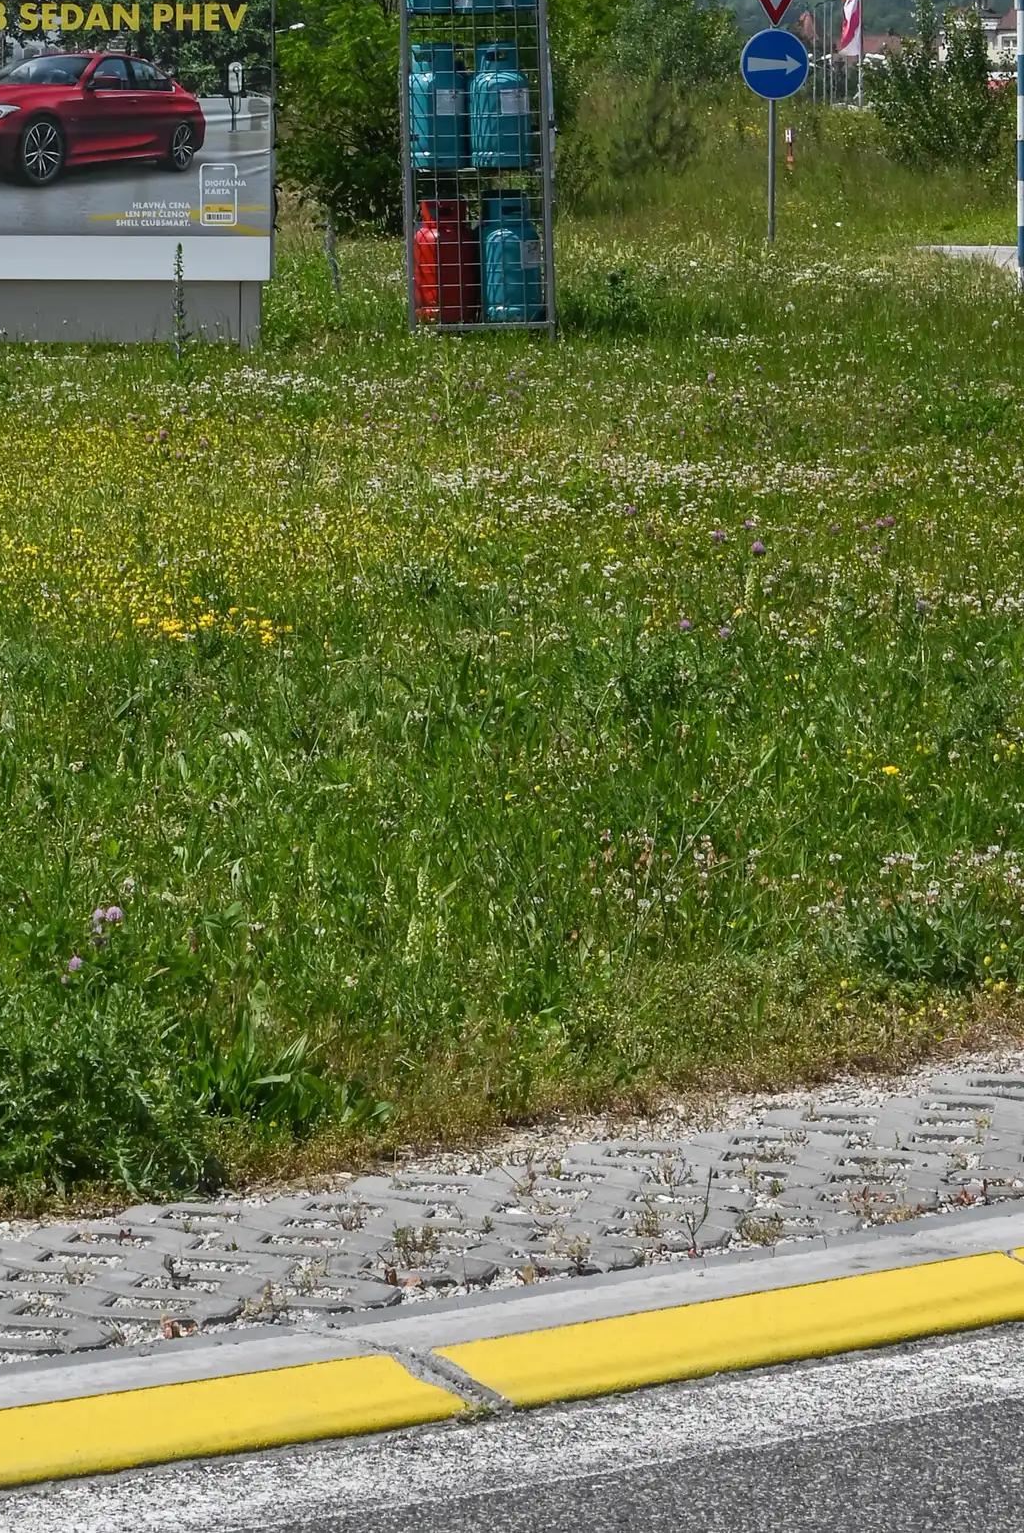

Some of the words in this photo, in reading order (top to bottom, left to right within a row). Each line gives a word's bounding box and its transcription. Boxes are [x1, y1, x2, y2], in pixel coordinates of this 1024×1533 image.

[19, 2, 140, 31] SEDAN
[153, 3, 248, 31] PHEV
[204, 179, 247, 187] DIGITÁLNA
[132, 200, 167, 209] HLAVNÁ
[125, 210, 141, 218] LEN
[142, 210, 157, 218] PRE
[116, 219, 139, 227] SHELL
